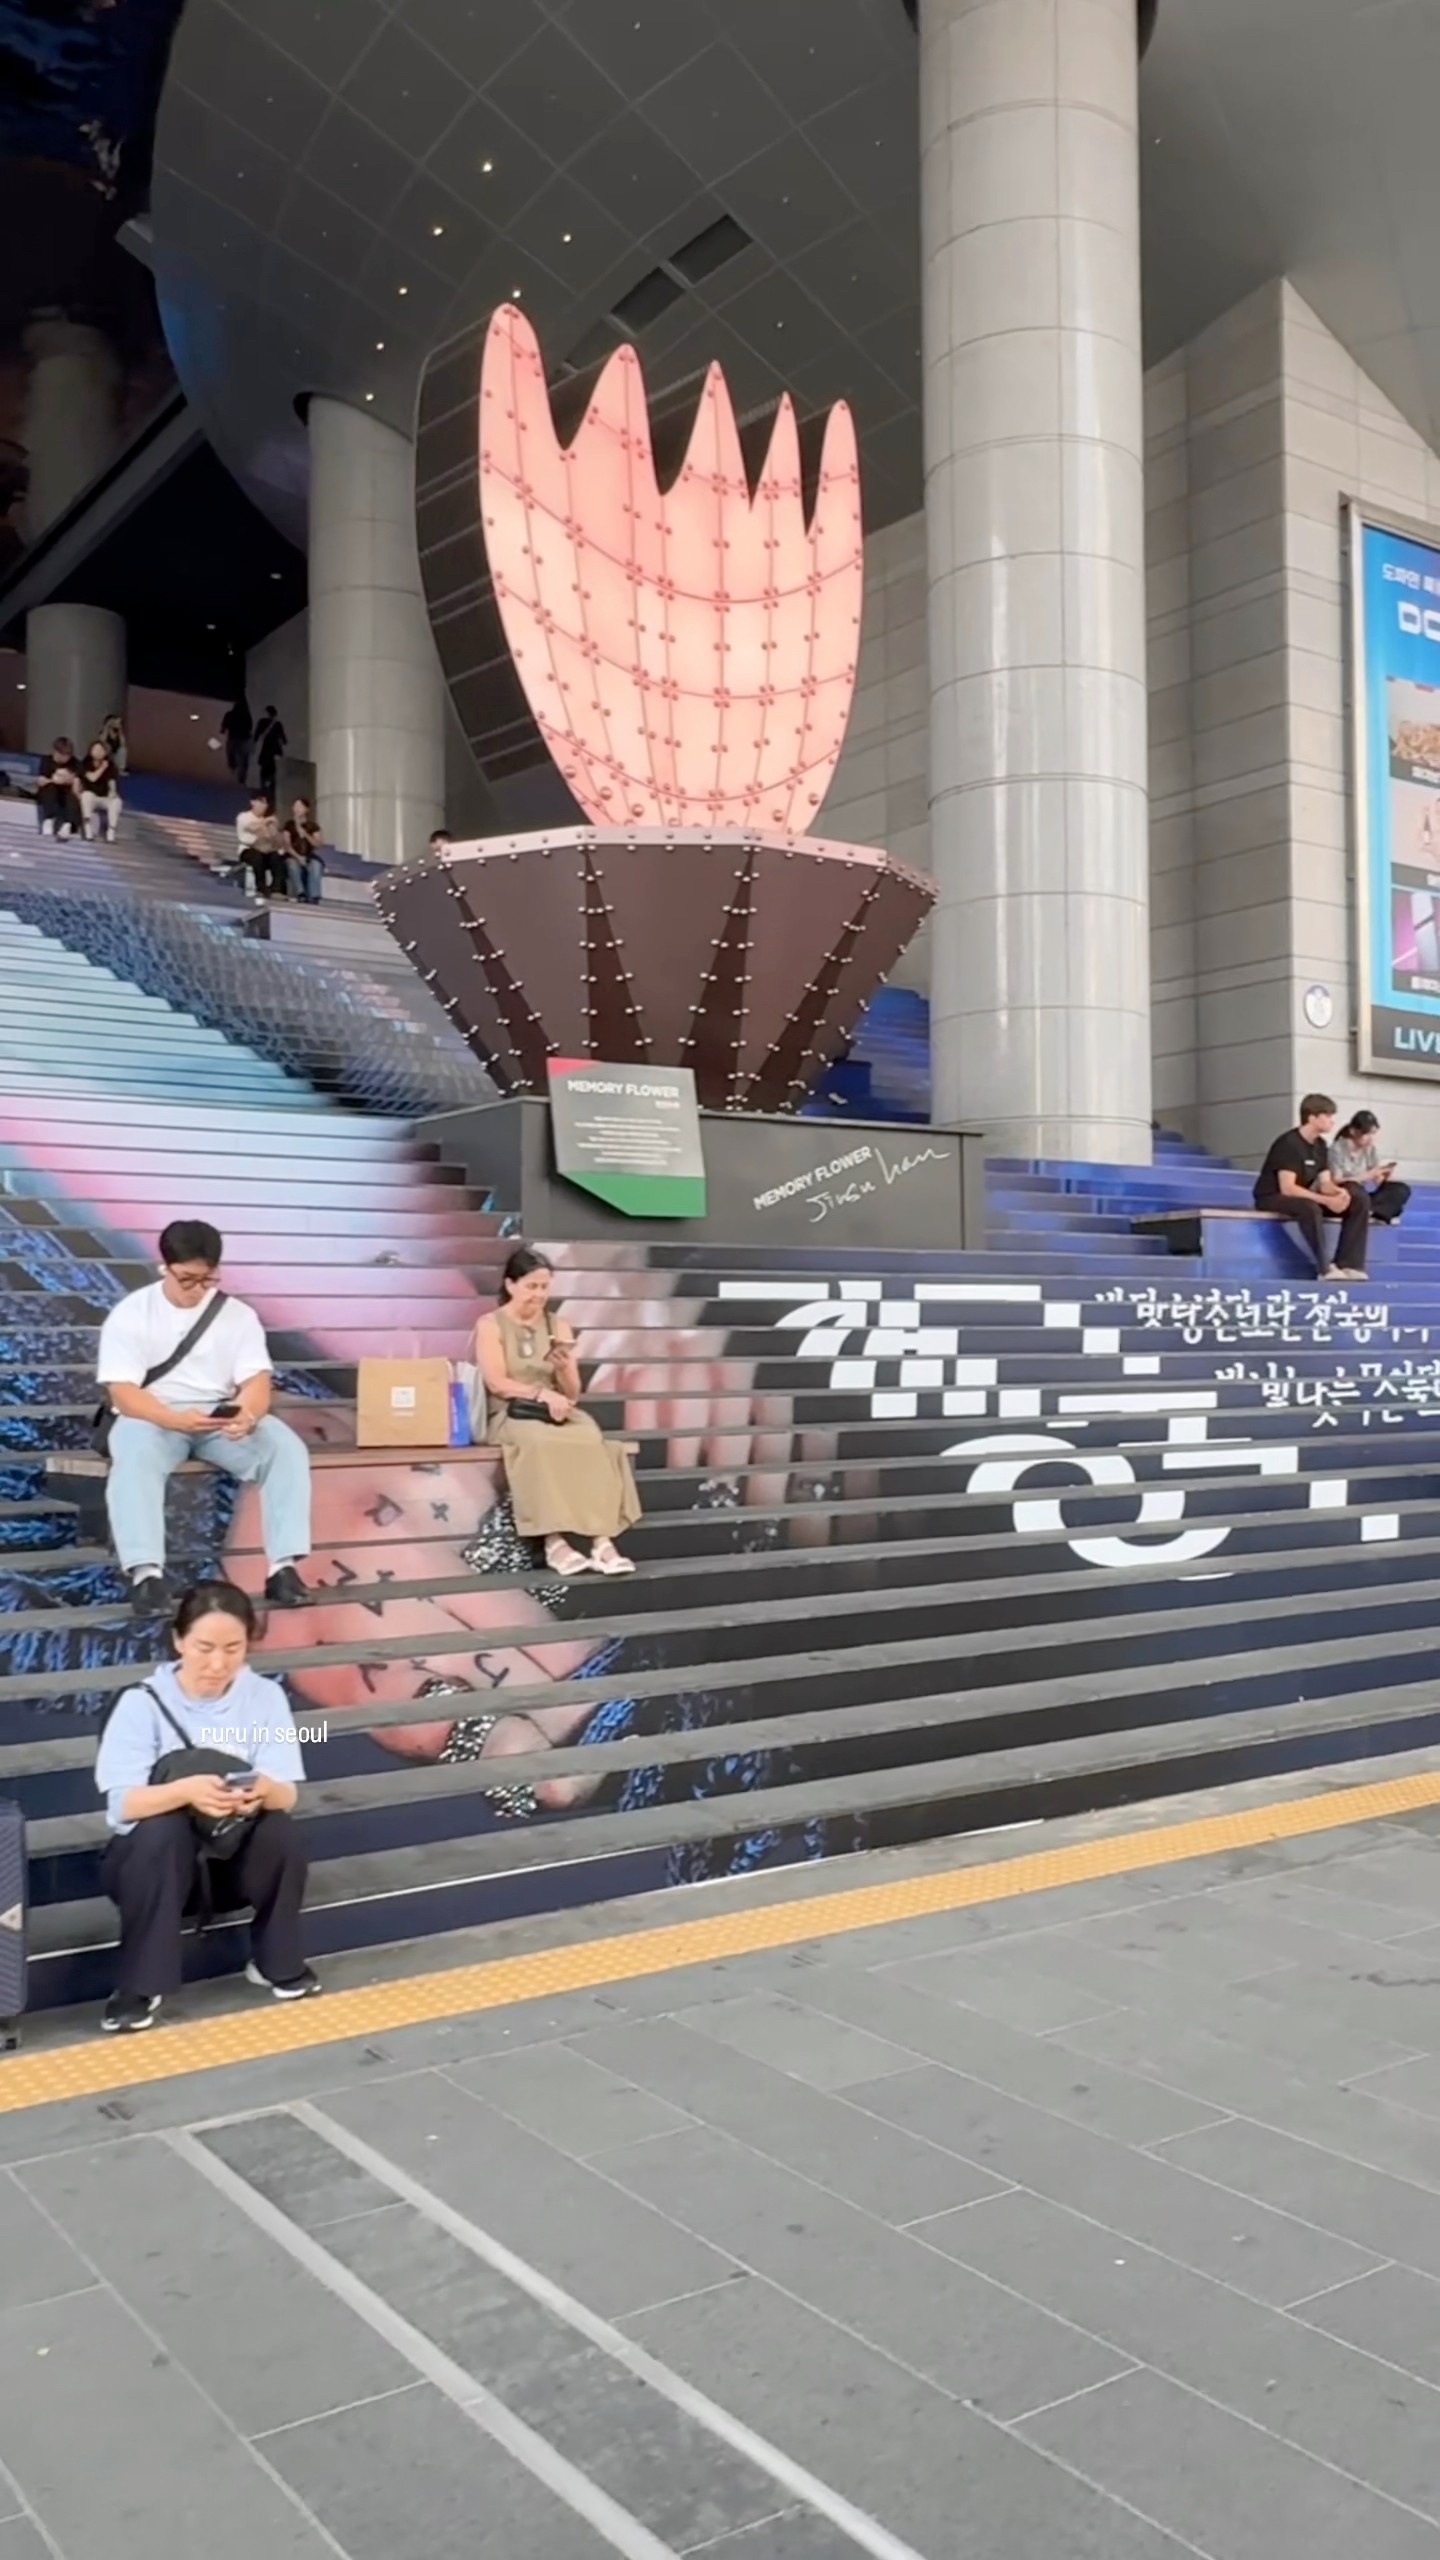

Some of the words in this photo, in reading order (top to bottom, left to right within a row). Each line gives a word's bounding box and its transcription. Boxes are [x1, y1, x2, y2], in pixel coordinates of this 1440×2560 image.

[567, 1080, 623, 1094] MEMORY
[626, 1084, 679, 1098] FLOWER
[753, 1172, 815, 1211] MEMORY
[815, 1145, 872, 1182] FLOWER
